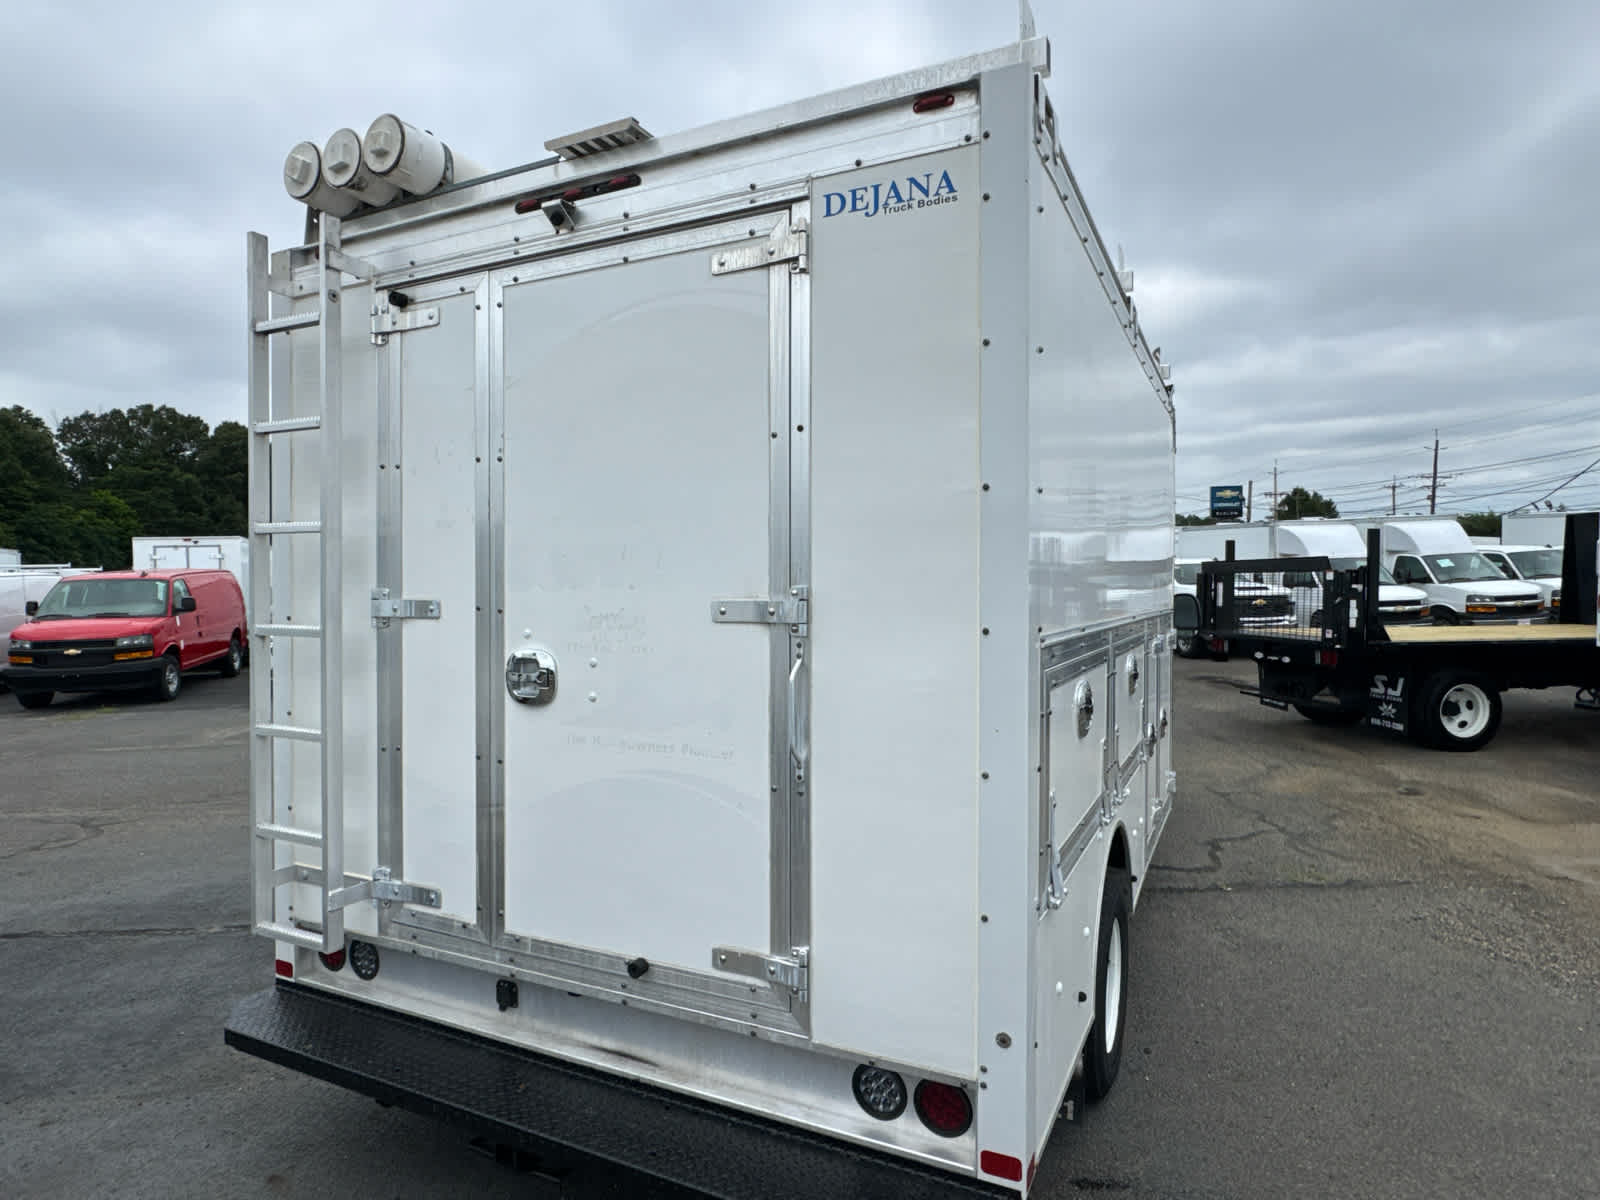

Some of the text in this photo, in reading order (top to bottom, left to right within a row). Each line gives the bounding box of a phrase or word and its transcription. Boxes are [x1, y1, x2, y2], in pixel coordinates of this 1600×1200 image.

[823, 169, 958, 218] DEJANA
[882, 195, 958, 215] Truck Bodies
